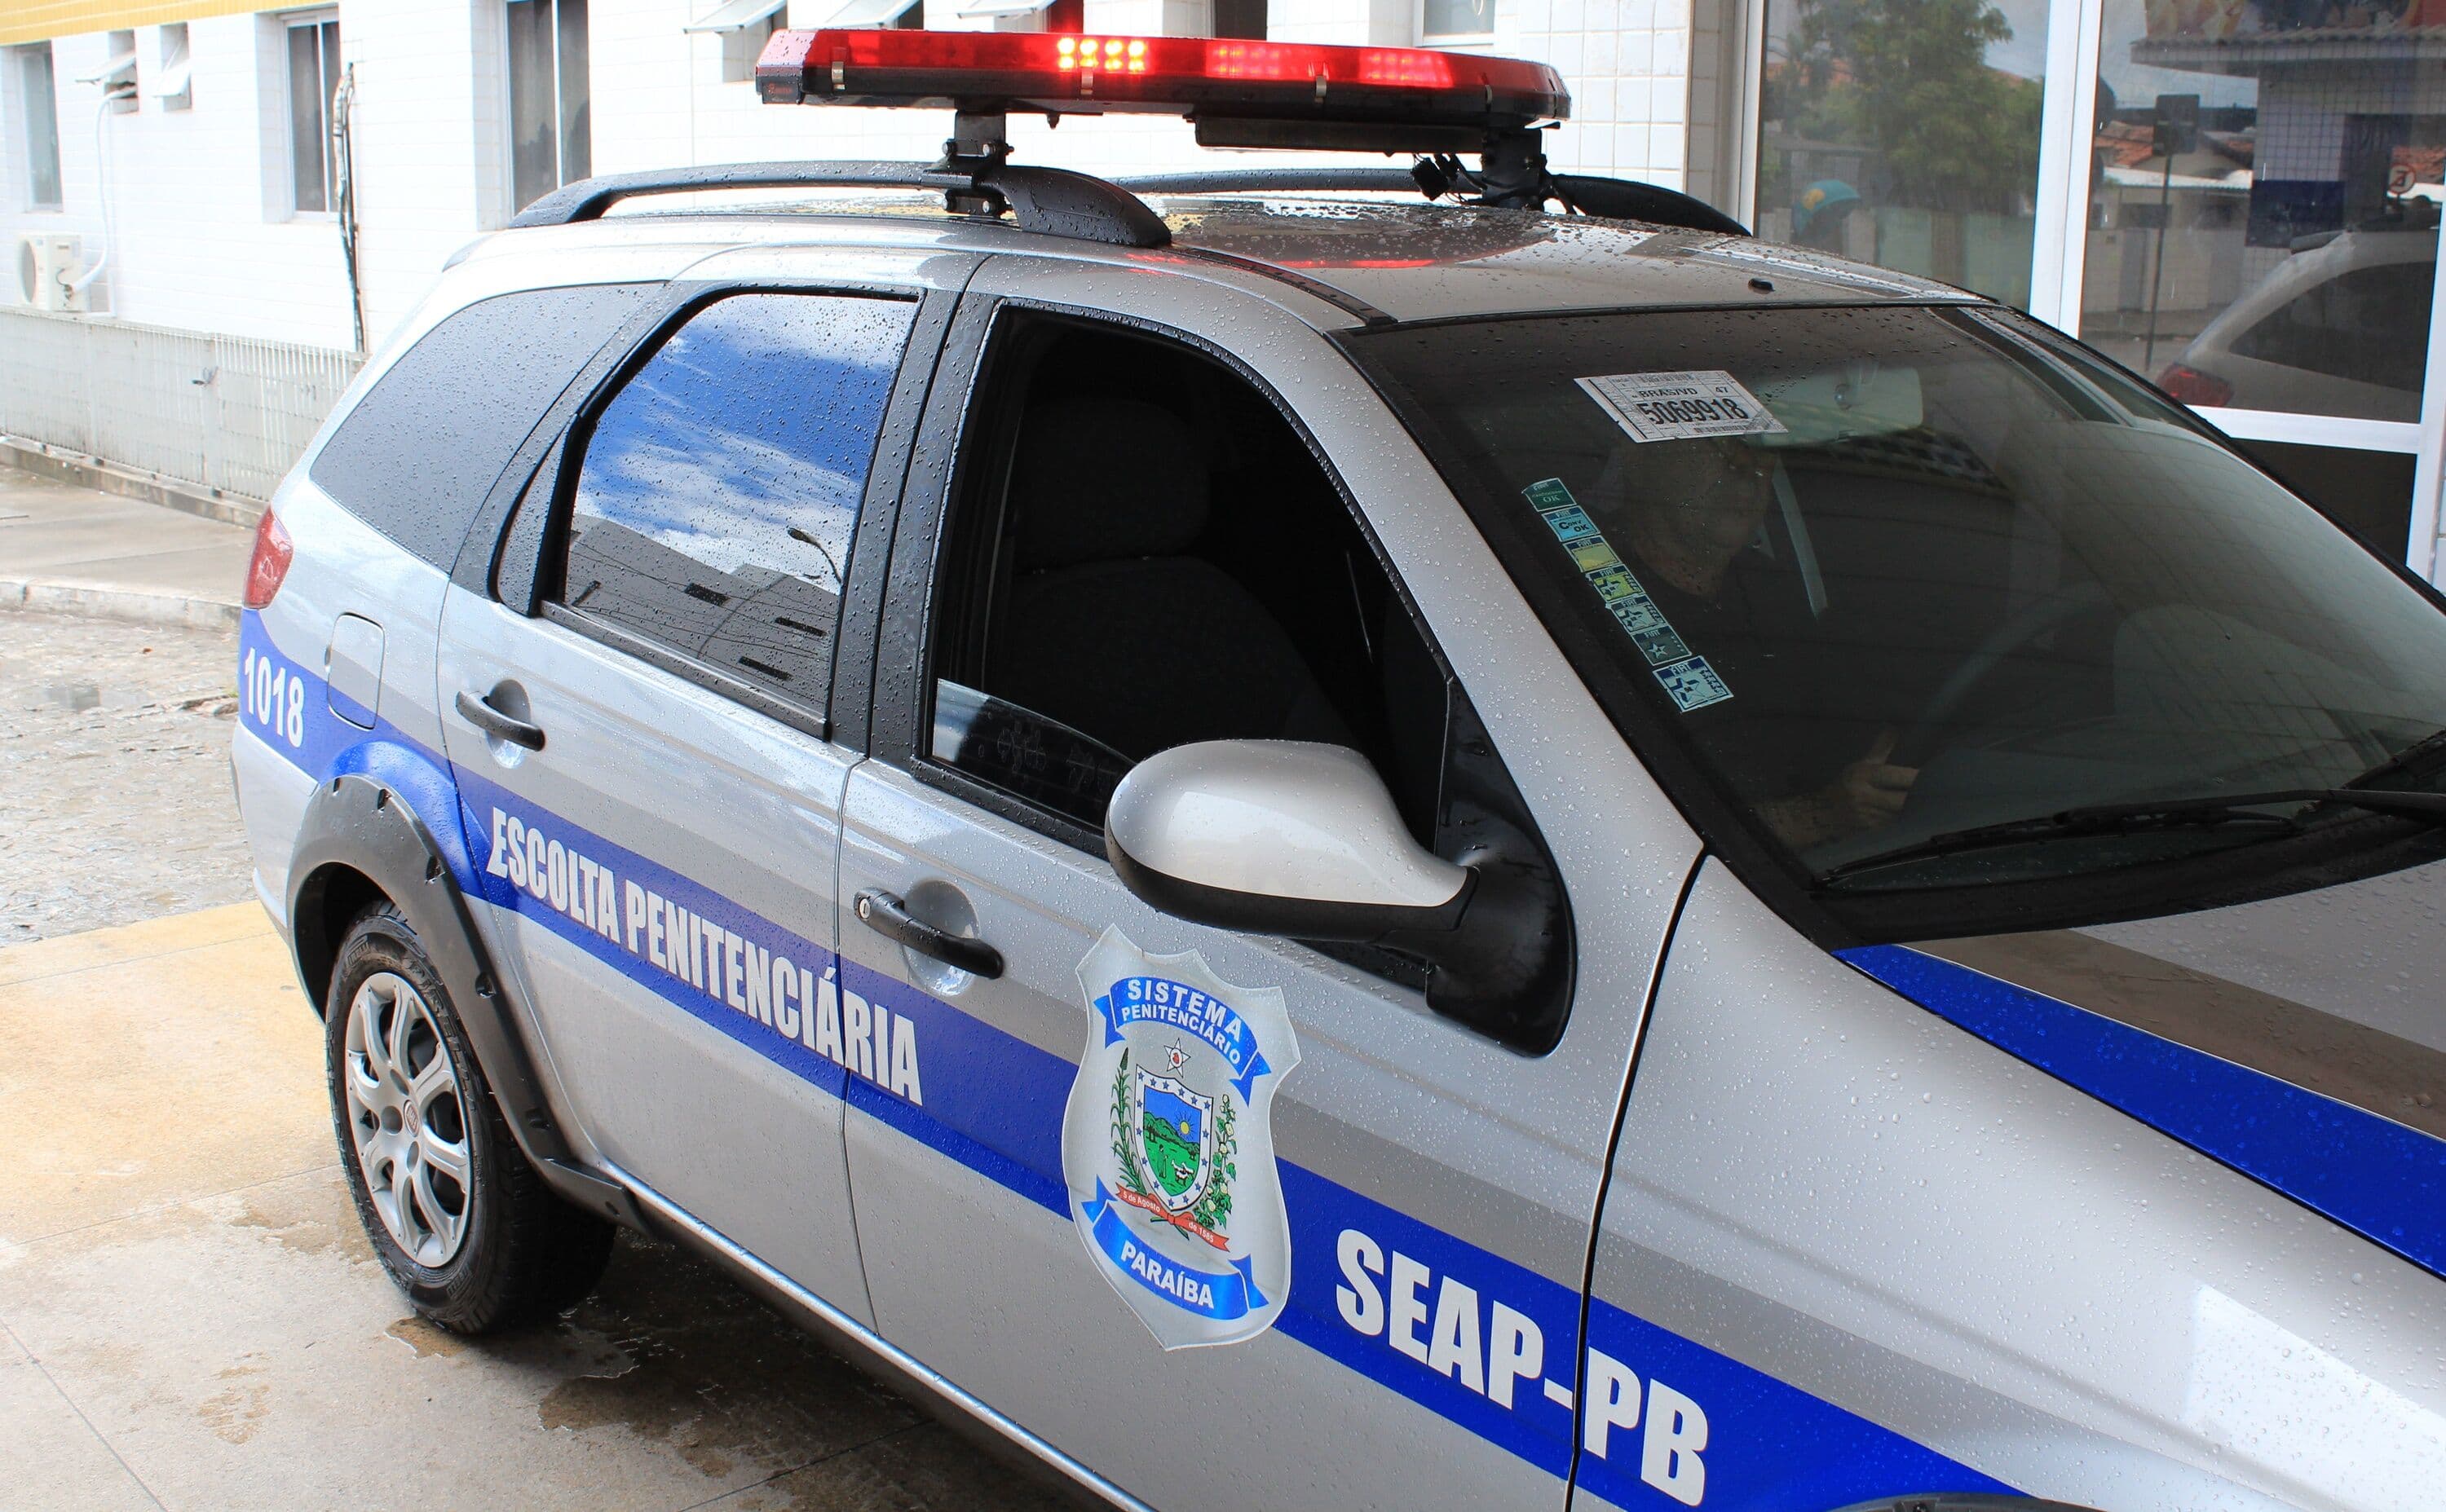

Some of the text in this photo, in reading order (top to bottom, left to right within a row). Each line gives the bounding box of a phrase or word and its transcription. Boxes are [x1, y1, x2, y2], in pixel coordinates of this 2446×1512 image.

[1636, 397, 1749, 425] 5069918
[1542, 494, 1561, 503] OK
[1573, 524, 1590, 532] OK
[1669, 662, 1692, 677] FIAT
[245, 647, 305, 748] 1018
[487, 806, 923, 1106] ESCOLTA PENITENCIÁRIA
[1128, 979, 1243, 1043] SISTEMA
[1121, 1003, 1241, 1065] PENITENCIÁRIO
[1123, 1190, 1161, 1213] 5 de Agosto
[1188, 1221, 1215, 1243] de 1585
[1120, 1240, 1215, 1309] PARAÍBA
[1336, 1228, 1708, 1507] SEAP-PB
